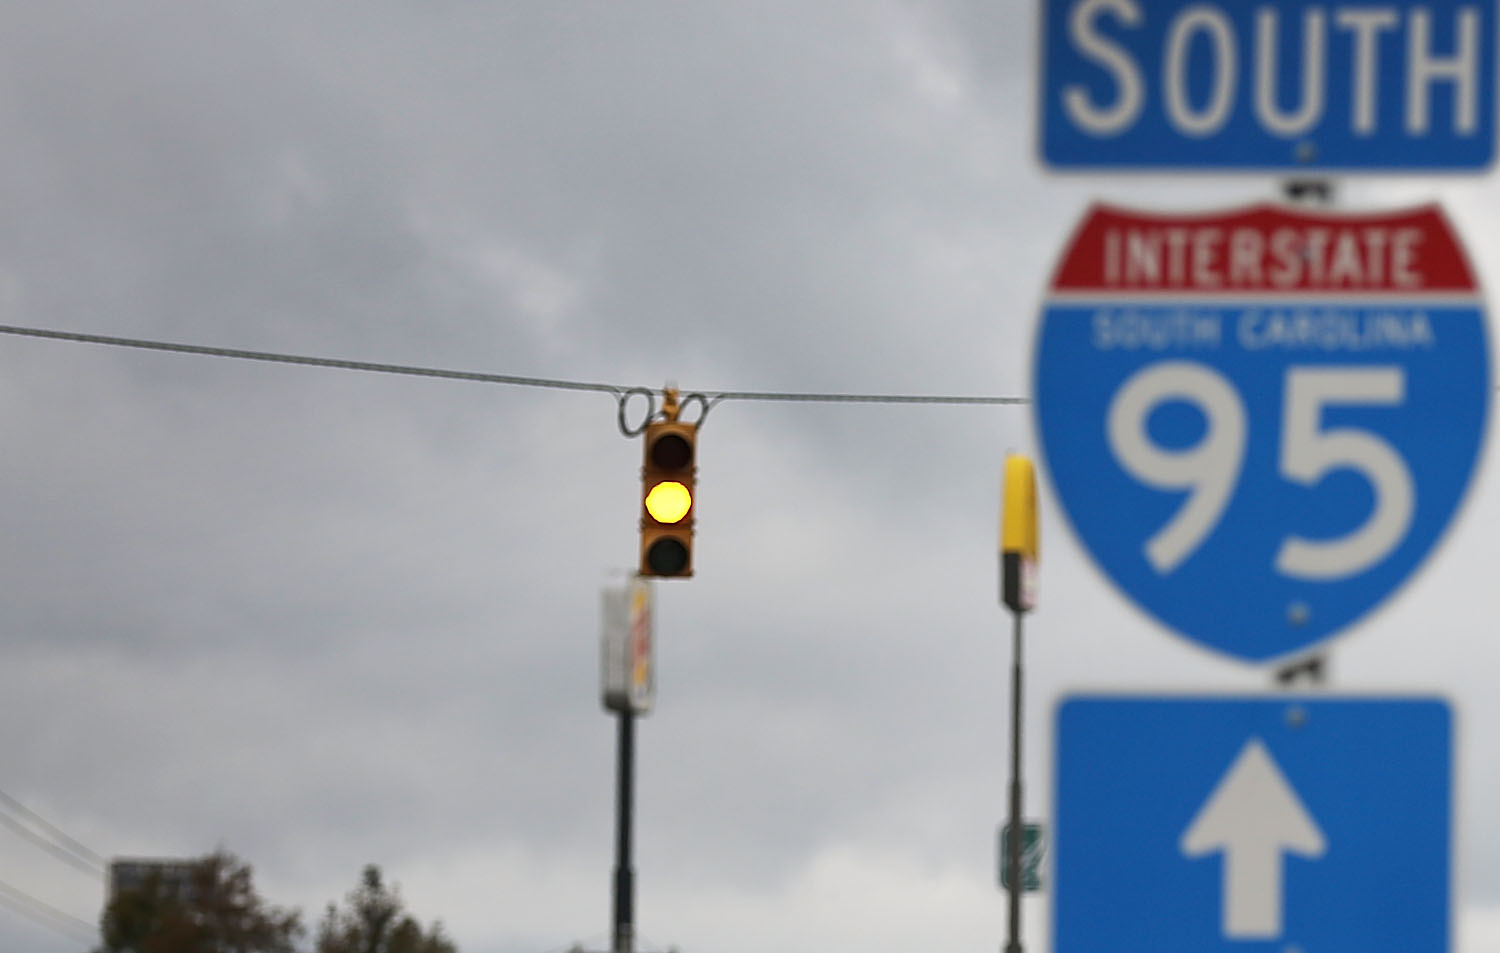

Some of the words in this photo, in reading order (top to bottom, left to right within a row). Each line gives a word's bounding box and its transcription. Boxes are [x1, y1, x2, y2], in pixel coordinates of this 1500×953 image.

[1063, 0, 1480, 135] SOUTH
[1105, 227, 1425, 290] INTERSTATE
[1093, 310, 1220, 350] SOUTH
[1238, 310, 1435, 350] CAROLINA
[1107, 361, 1415, 581] 95
